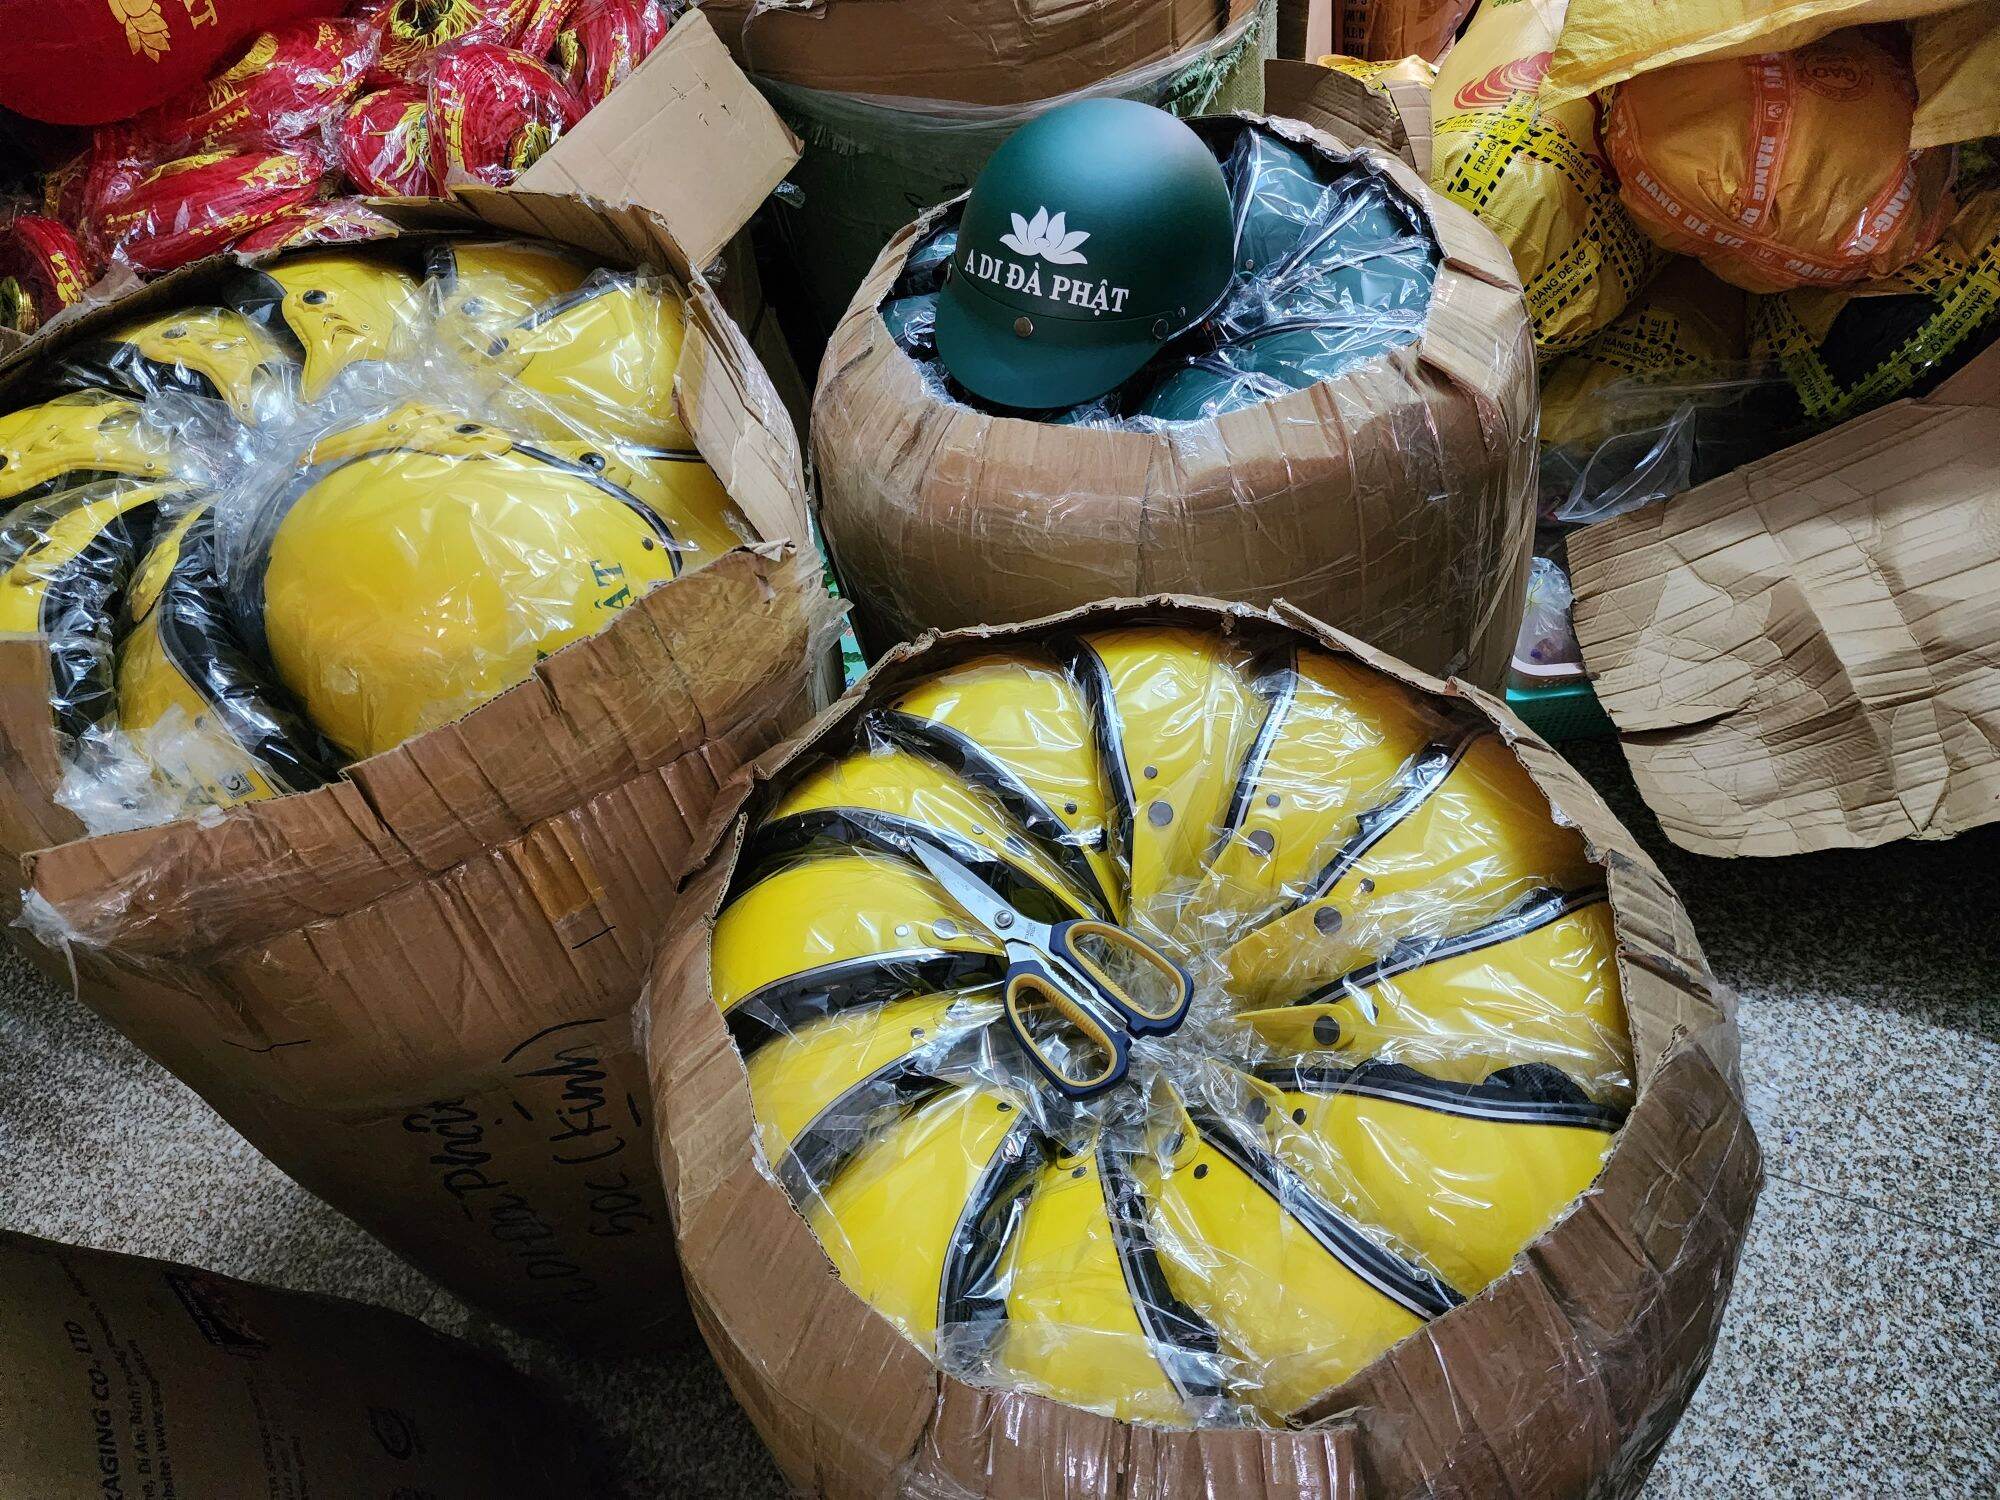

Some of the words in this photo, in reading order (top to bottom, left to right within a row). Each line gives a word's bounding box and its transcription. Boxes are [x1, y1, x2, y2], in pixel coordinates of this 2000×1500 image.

[1547, 139, 1593, 181] FRAGILE
[977, 254, 1004, 284] DI
[1004, 262, 1043, 297] ĐÀ
[1049, 273, 1130, 318] PHẬT
[63, 1318, 94, 1355] LTD
